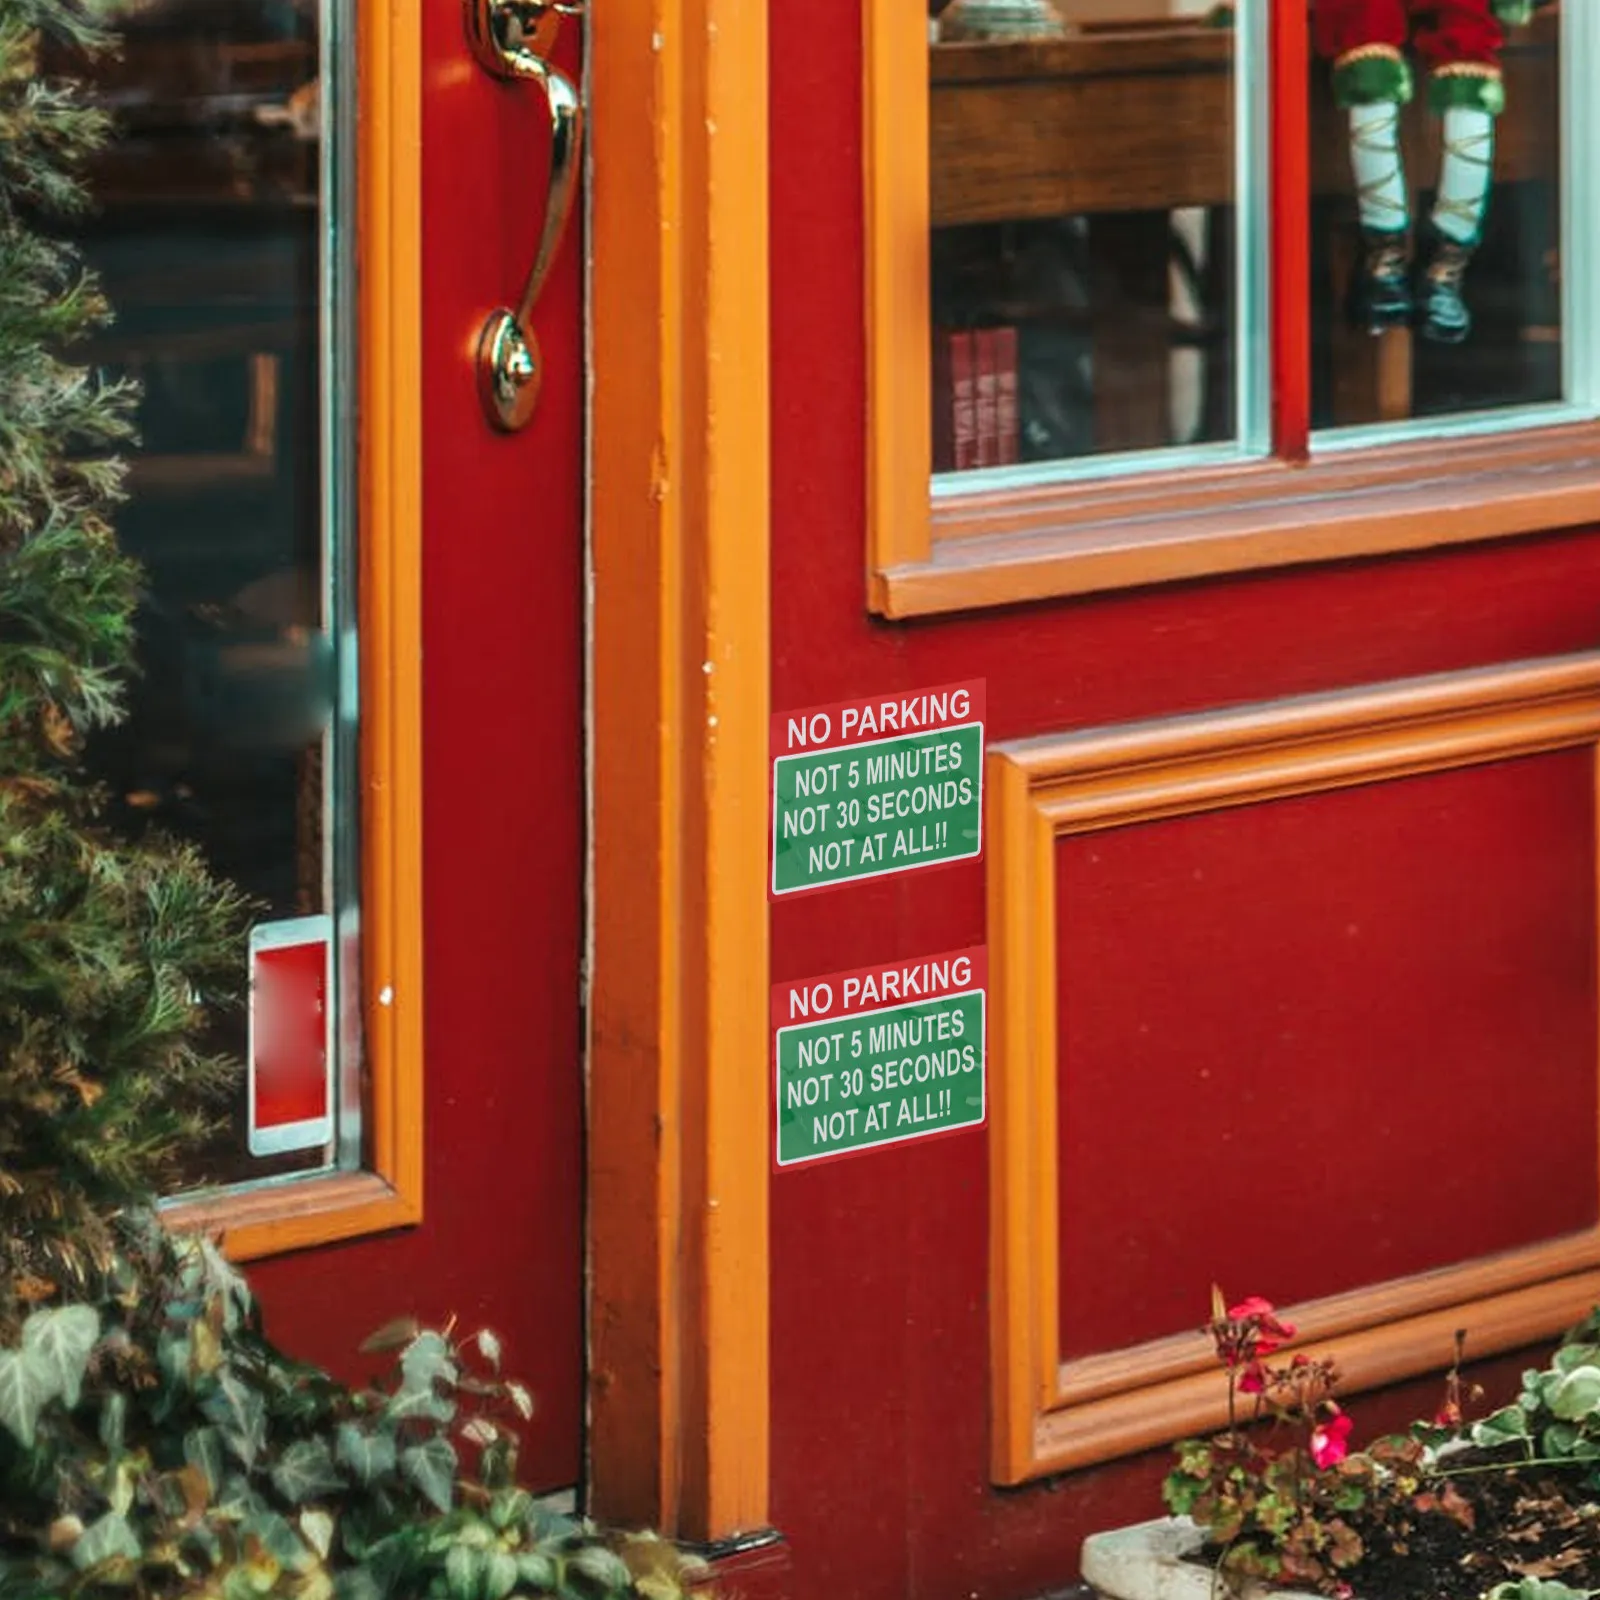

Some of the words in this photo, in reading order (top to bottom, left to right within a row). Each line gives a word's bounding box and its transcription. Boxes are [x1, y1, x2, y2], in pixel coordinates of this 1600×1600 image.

[788, 714, 831, 748] NO
[842, 689, 969, 739] PARKING
[796, 764, 841, 798] NOT
[849, 761, 859, 788] 5
[867, 742, 962, 785] MINUTES
[784, 804, 830, 838] NOT
[837, 799, 859, 829] 30
[867, 778, 972, 822] SECONDS
[809, 839, 854, 874] NOT
[860, 833, 887, 864] AT
[892, 822, 947, 858] ALL!!
[790, 984, 832, 1018] NO
[843, 957, 971, 1008] PARKING
[798, 1033, 844, 1068] NOT
[851, 1030, 862, 1058] 5
[869, 1009, 964, 1054] MINUTES
[788, 1074, 833, 1109] NOT
[840, 1068, 863, 1099] 30
[871, 1045, 975, 1092] SECONDS
[814, 1109, 858, 1144] NOT
[864, 1102, 891, 1133] AT
[897, 1090, 951, 1126] ALL!!
